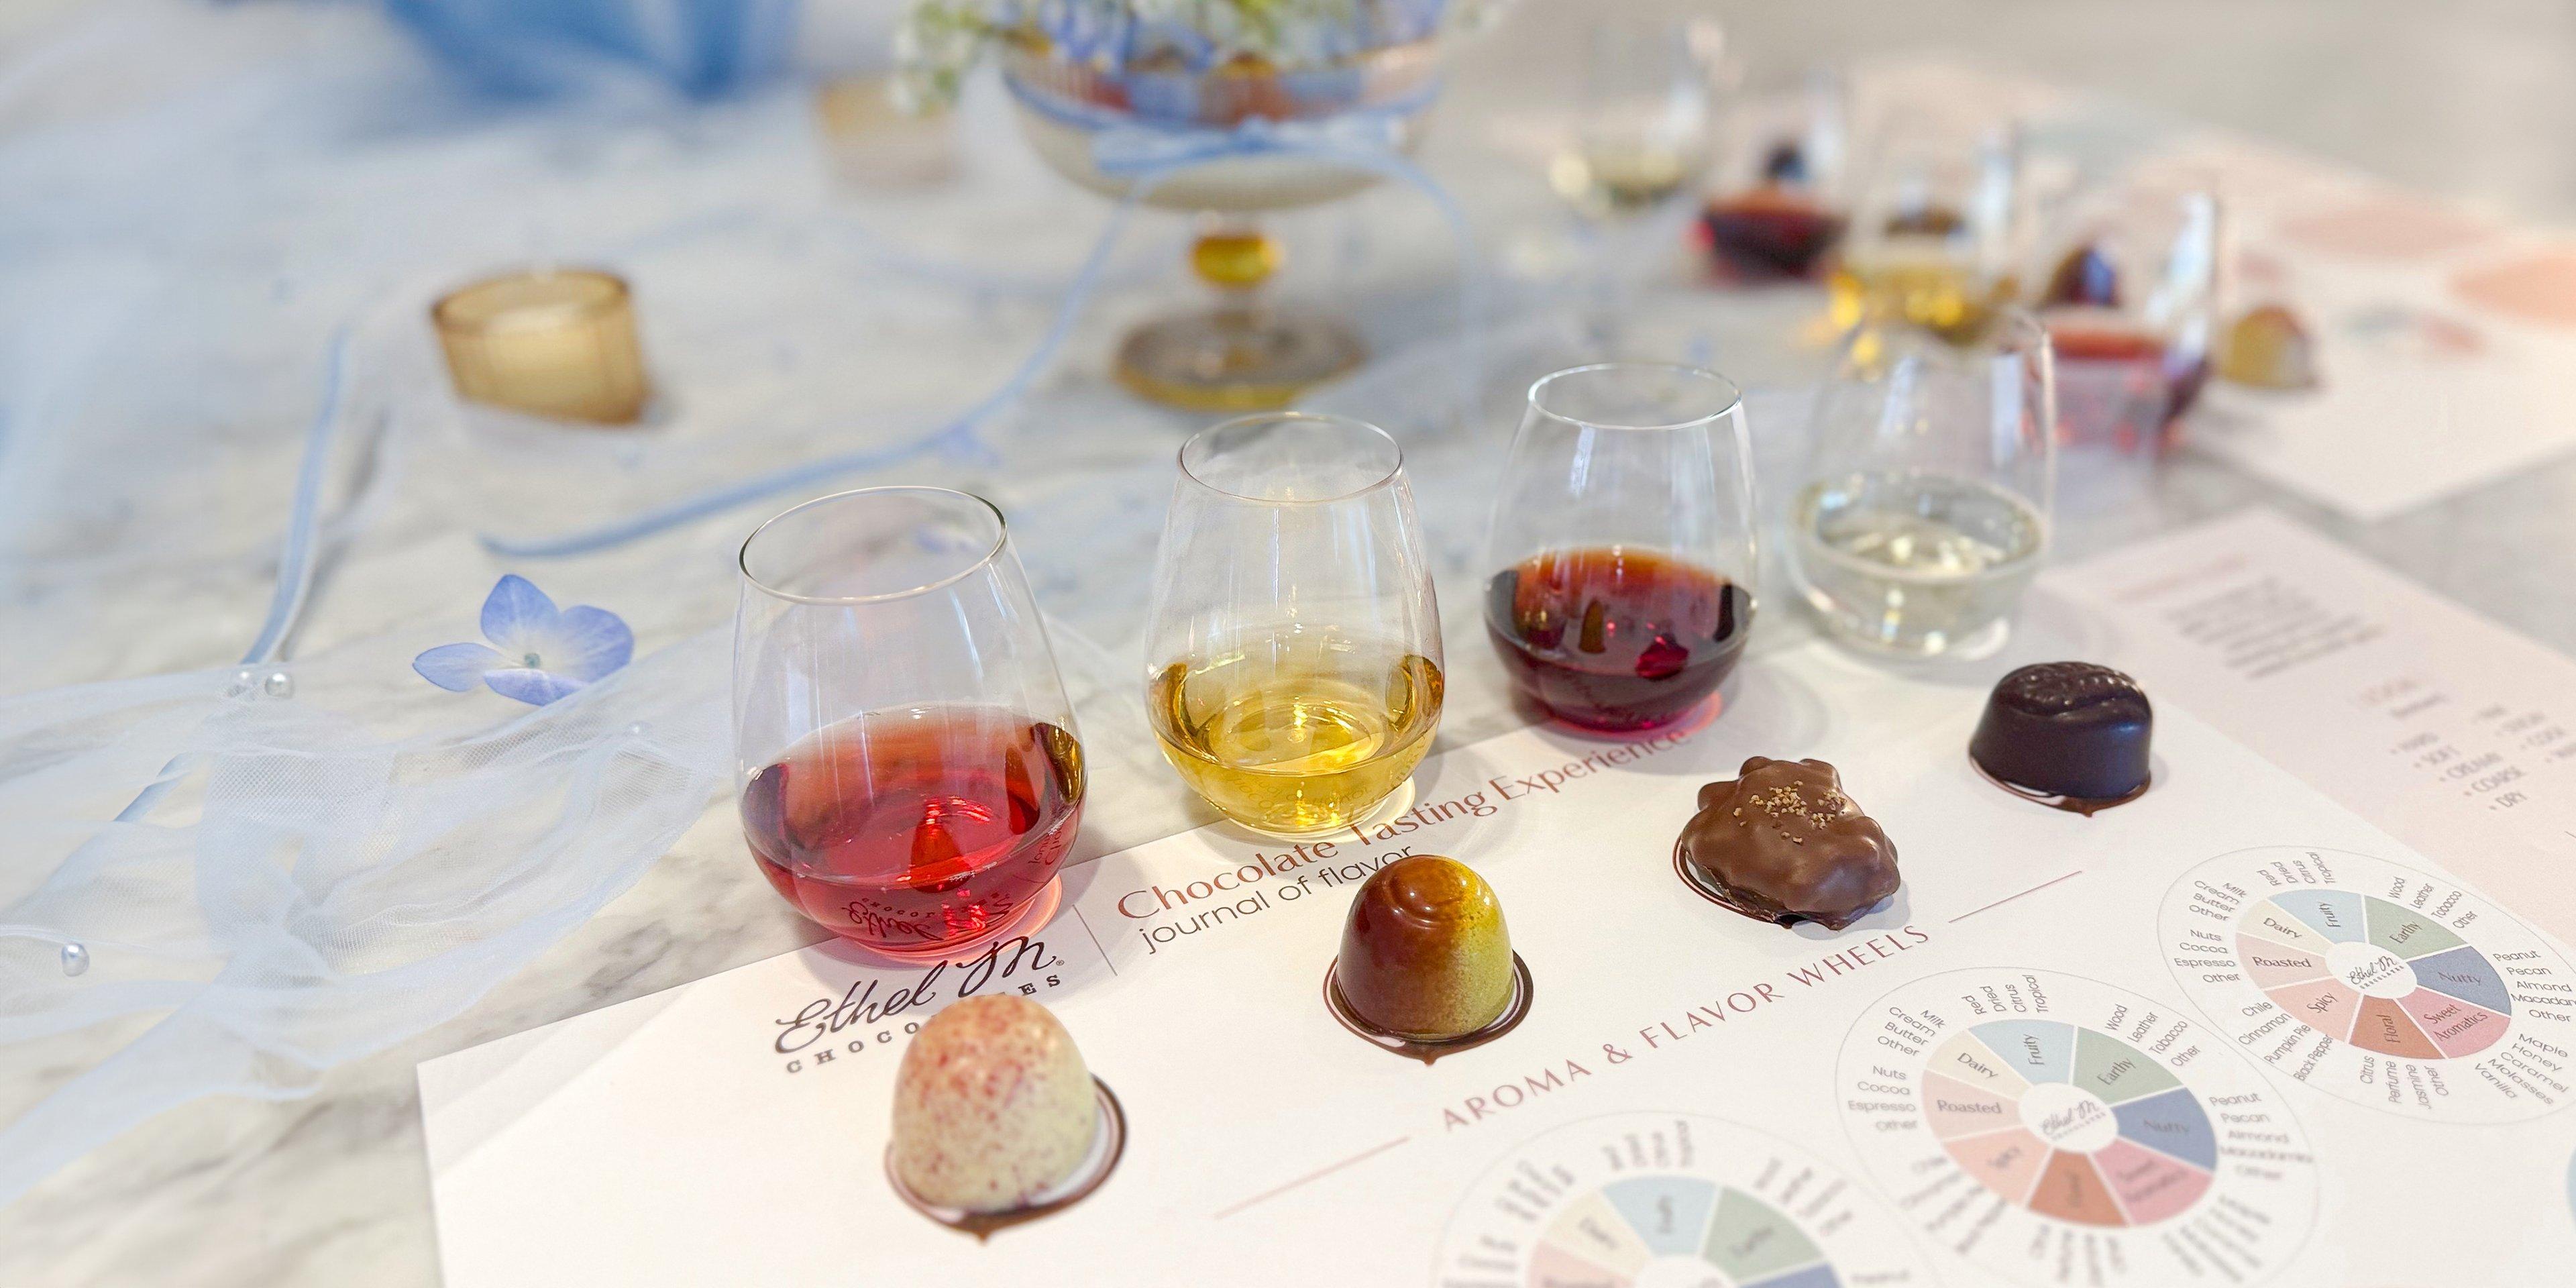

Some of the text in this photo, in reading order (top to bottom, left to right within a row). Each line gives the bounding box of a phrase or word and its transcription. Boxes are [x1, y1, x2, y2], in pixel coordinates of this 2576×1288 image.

[2496, 792, 2528, 808] DRY
[1117, 841, 1338, 920] Chocolate
[1339, 791, 1497, 846] Tasting
[1489, 731, 1691, 801] Experience
[2257, 869, 2282, 886] Red
[2270, 861, 2298, 883] Dried
[2293, 860, 2316, 883] Citrus
[2306, 851, 2336, 885] Tropical
[1139, 845, 1411, 954] journal of flavor
[2194, 880, 2240, 905] Cream
[2222, 882, 2247, 898] Milk
[2387, 875, 2407, 899] Wood
[2410, 883, 2434, 909] Leather
[2189, 905, 2229, 922] Other
[2193, 893, 2235, 912] Butter
[2319, 901, 2341, 928] Fruity
[2431, 890, 2462, 919] Tobacco
[2263, 918, 2302, 938] Dairy
[2453, 910, 2478, 929] Other
[2190, 929, 2222, 941] Nuts
[2390, 921, 2422, 944] Earthy
[2180, 943, 2228, 954] Cocoa
[2493, 950, 2541, 962] Peanut
[2174, 958, 2236, 969] Espresso
[2252, 957, 2311, 968] Roasted
[2506, 966, 2552, 976] Pecan
[2202, 973, 2241, 983] Other
[2438, 971, 2481, 986] Nutty
[2516, 980, 2572, 993] Almond
[1962, 995, 1987, 1015] Red
[1979, 985, 2006, 1012] Dried
[2005, 983, 2027, 1012] Citrus
[2022, 974, 2048, 1014] Tropical
[2306, 991, 2339, 1014] Spicy
[775, 961, 948, 1054] Ethel
[1920, 1010, 1947, 1029] Milk
[2104, 1003, 2128, 1031] Wood
[2242, 1001, 2272, 1017] Chile
[2424, 1004, 2461, 1024] Sweet
[2528, 1010, 2571, 1022] Other
[786, 975, 1061, 1073] CHOCOES
[1442, 925, 1929, 1132] AROMA & FLAVOR WHEELS
[1884, 1021, 1929, 1046] Butter
[1889, 1007, 1935, 1037] Cream
[2127, 1011, 2159, 1043] Leather
[2238, 1012, 2293, 1045] Cinnamon
[2376, 1014, 2401, 1043] Floral
[2432, 1011, 2489, 1041] Aromatics
[1877, 1035, 1921, 1057] Other
[2023, 1034, 2045, 1065] Fruity
[2148, 1020, 2188, 1055] Tobacco
[2263, 1024, 2311, 1064] Pumpkin Pie
[2518, 1033, 2568, 1058] Maple
[1957, 1052, 1999, 1079] Dairy
[2171, 1044, 2201, 1067] Other
[2293, 1034, 2334, 1081] Black Pepper
[2512, 1043, 2563, 1072] Honey
[1872, 1065, 1907, 1080] Nuts
[2096, 1057, 2137, 1085] Earthy
[2360, 1055, 2375, 1084] Citrus
[2385, 1060, 2402, 1104] Perfume
[2424, 1065, 2449, 1097] Other
[2475, 1063, 2519, 1099] Vanilla
[2500, 1052, 2569, 1093] Caramel
[1858, 1081, 1911, 1095] Cocoa
[2406, 1064, 2432, 1110] Jasmine
[2487, 1059, 2554, 1106] Molasses
[1847, 1099, 1917, 1114] Espresso
[1937, 1099, 2002, 1114] Roasted
[2208, 1092, 2262, 1106] Peanut
[2220, 1112, 2270, 1123] Pecan
